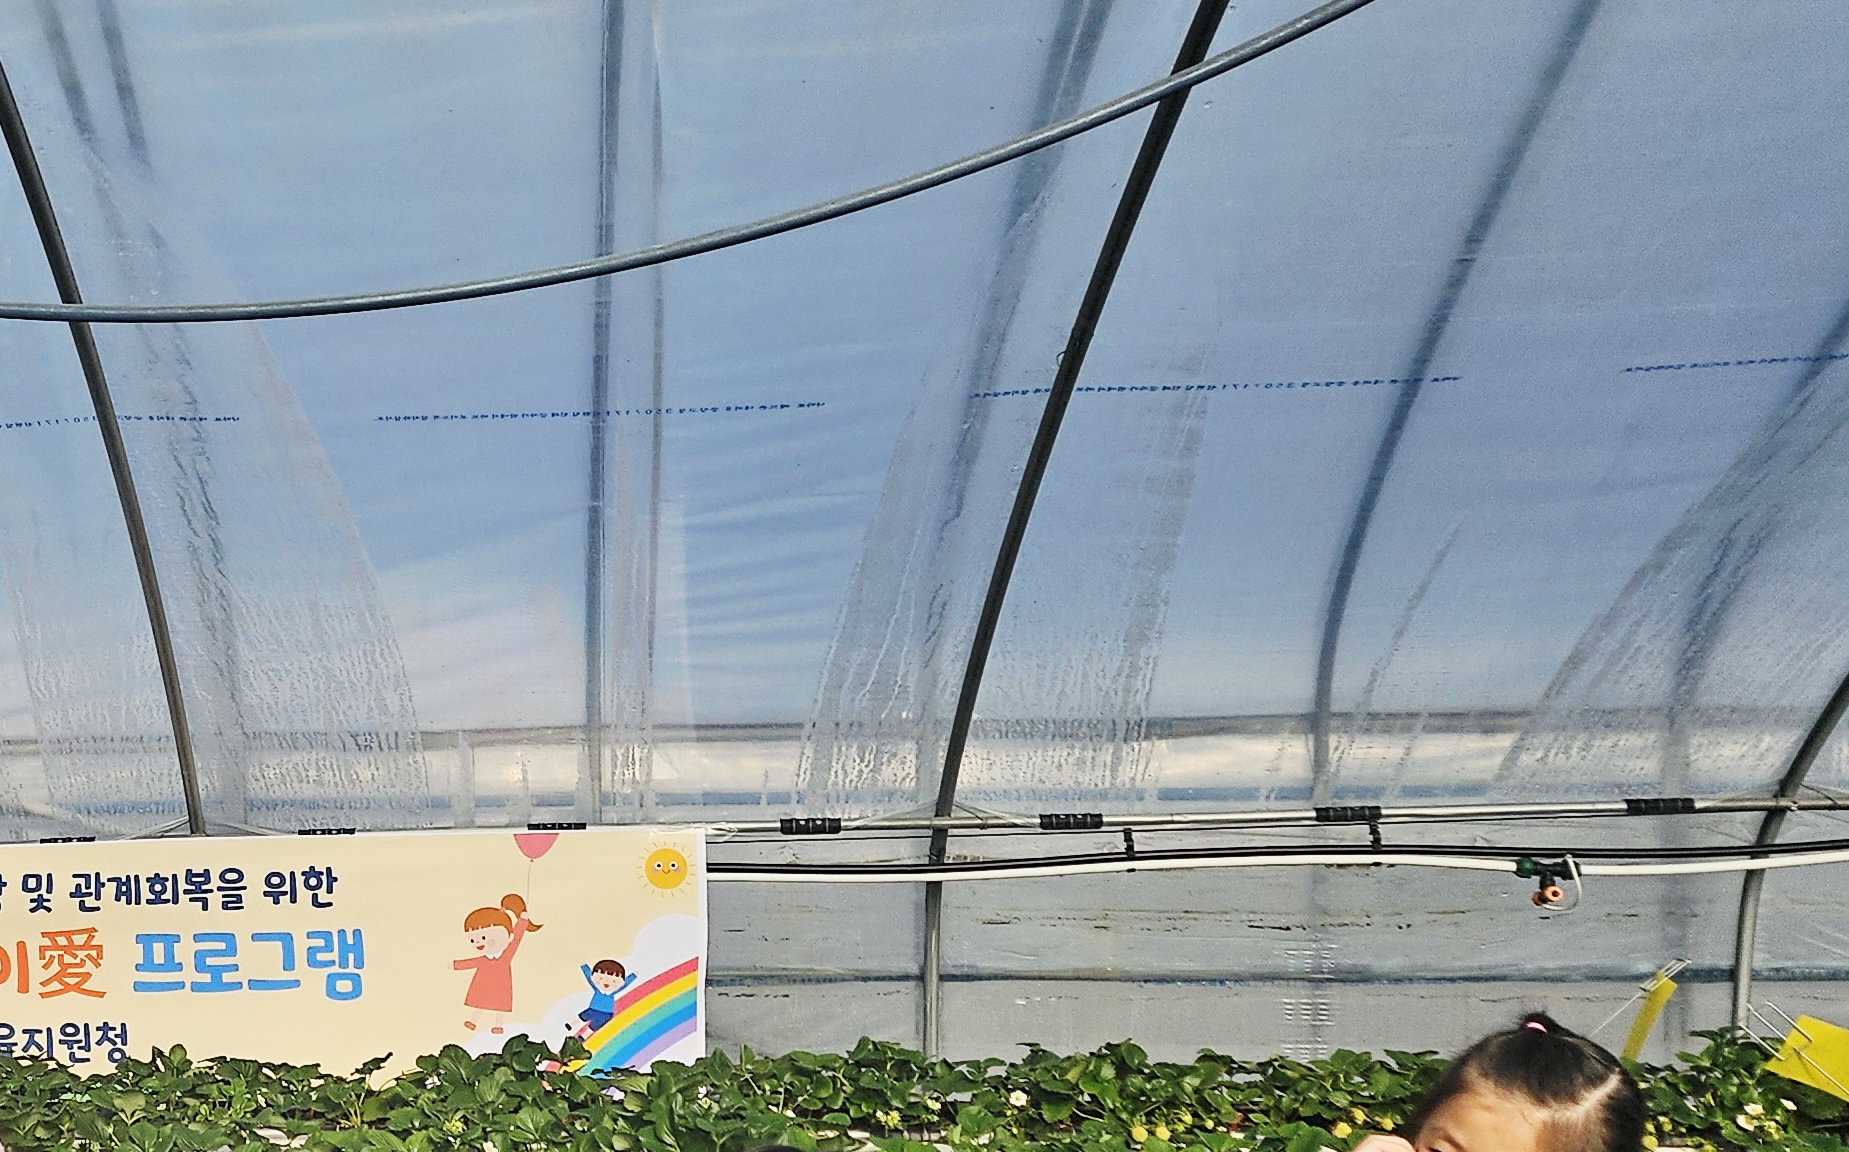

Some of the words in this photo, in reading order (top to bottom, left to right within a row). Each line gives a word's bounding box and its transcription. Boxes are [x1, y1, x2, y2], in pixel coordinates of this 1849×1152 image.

[21, 872, 54, 914] 및
[68, 867, 248, 913] 관계회복을
[262, 865, 339, 909] 위한
[132, 928, 365, 1001] 프로그램
